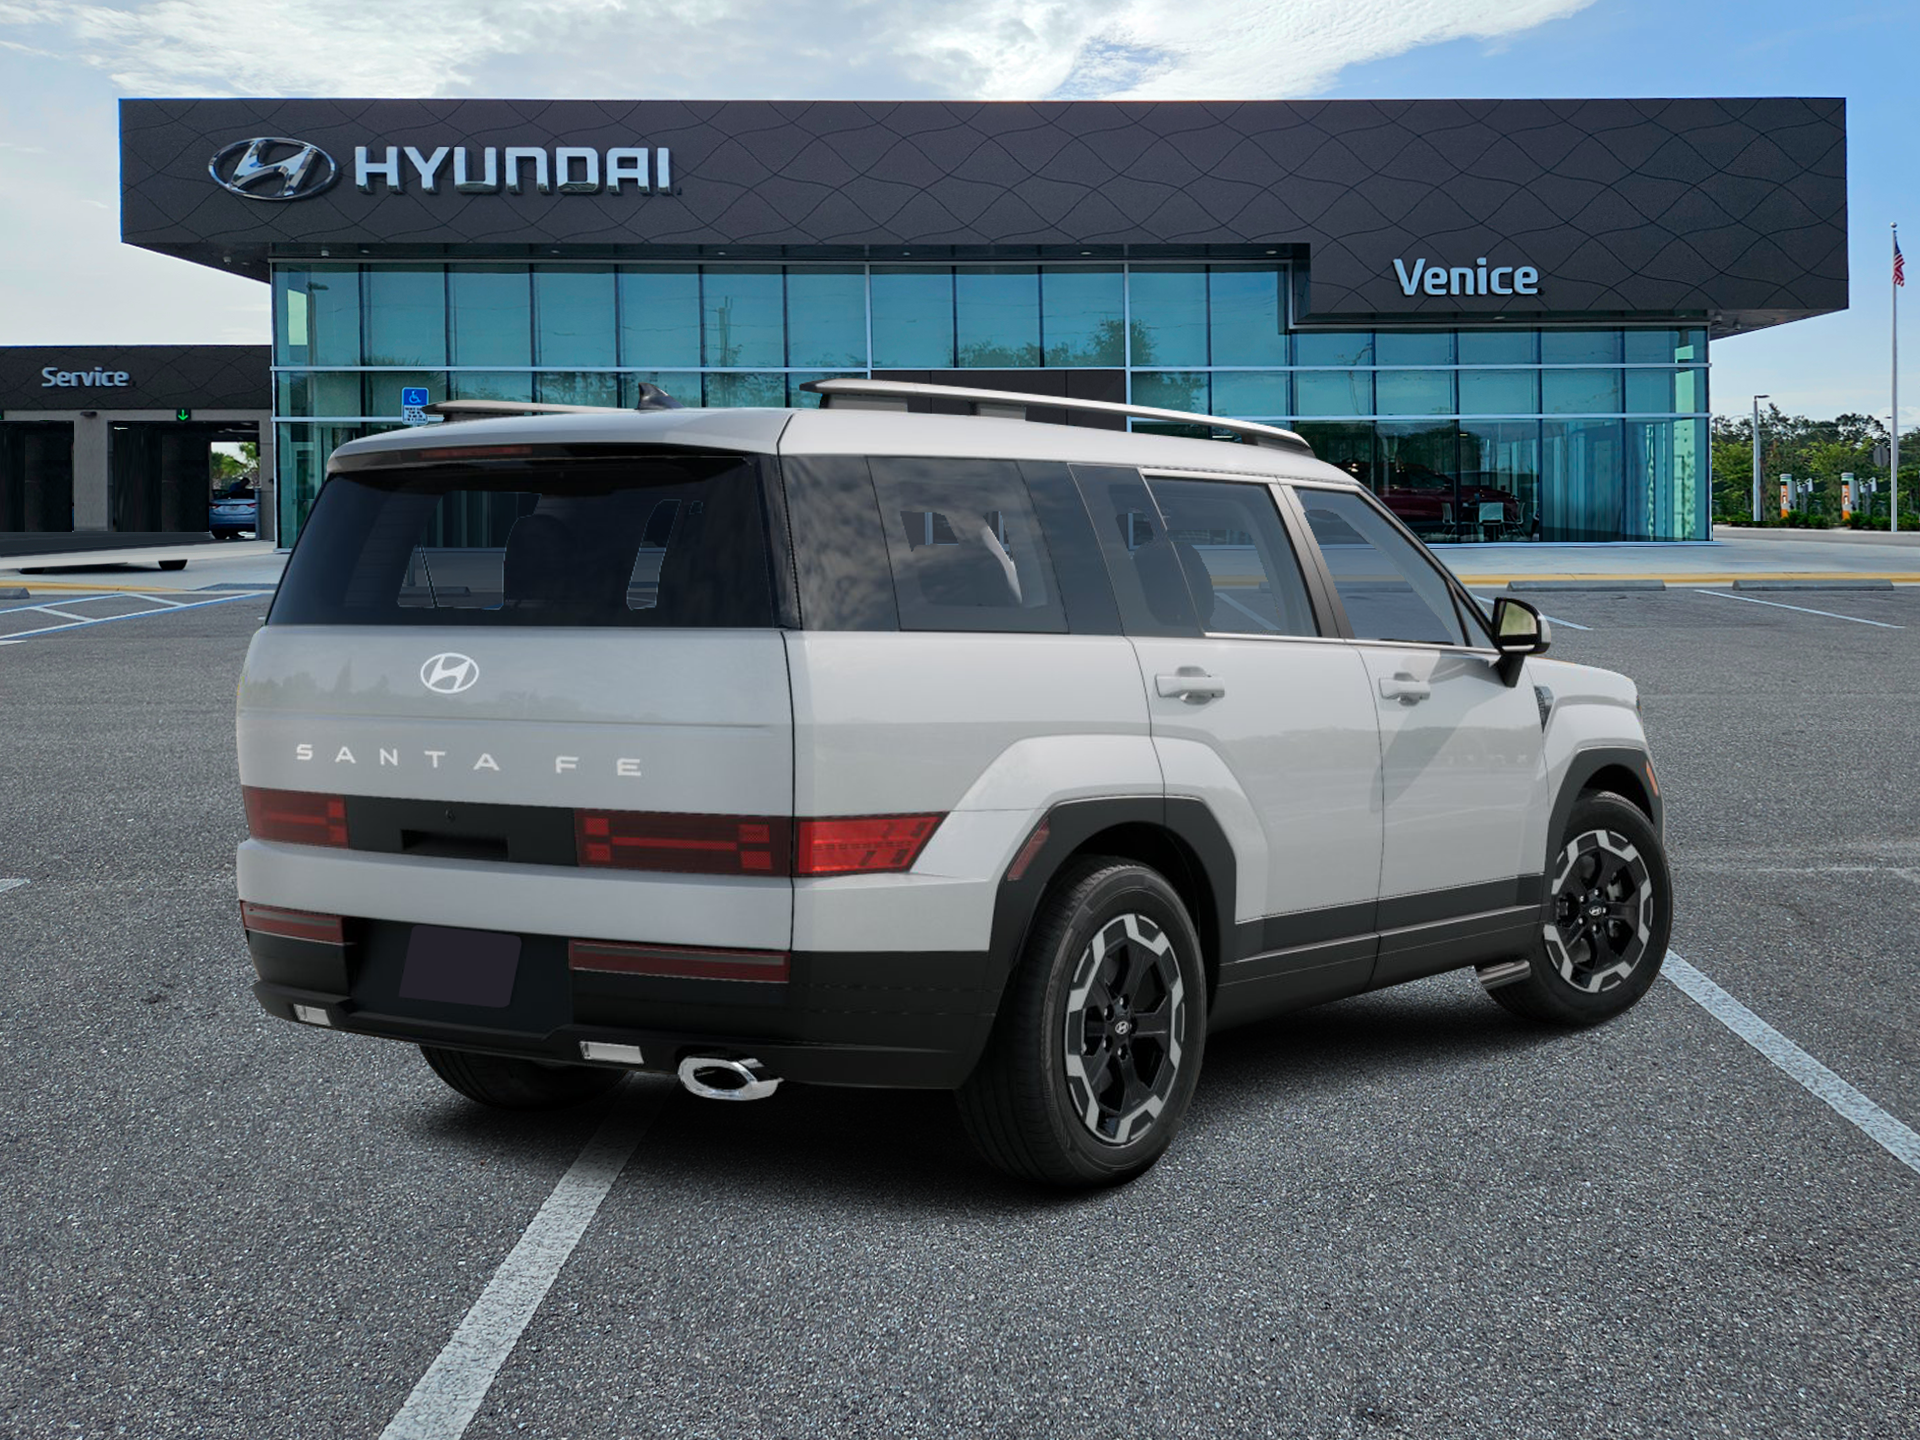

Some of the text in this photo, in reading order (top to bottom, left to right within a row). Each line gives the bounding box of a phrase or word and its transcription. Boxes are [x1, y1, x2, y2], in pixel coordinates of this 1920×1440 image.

[354, 146, 673, 194] HYUNDAI
[1392, 257, 1539, 296] Venice
[41, 366, 130, 387] Service
[296, 744, 642, 777] SANTA FE
